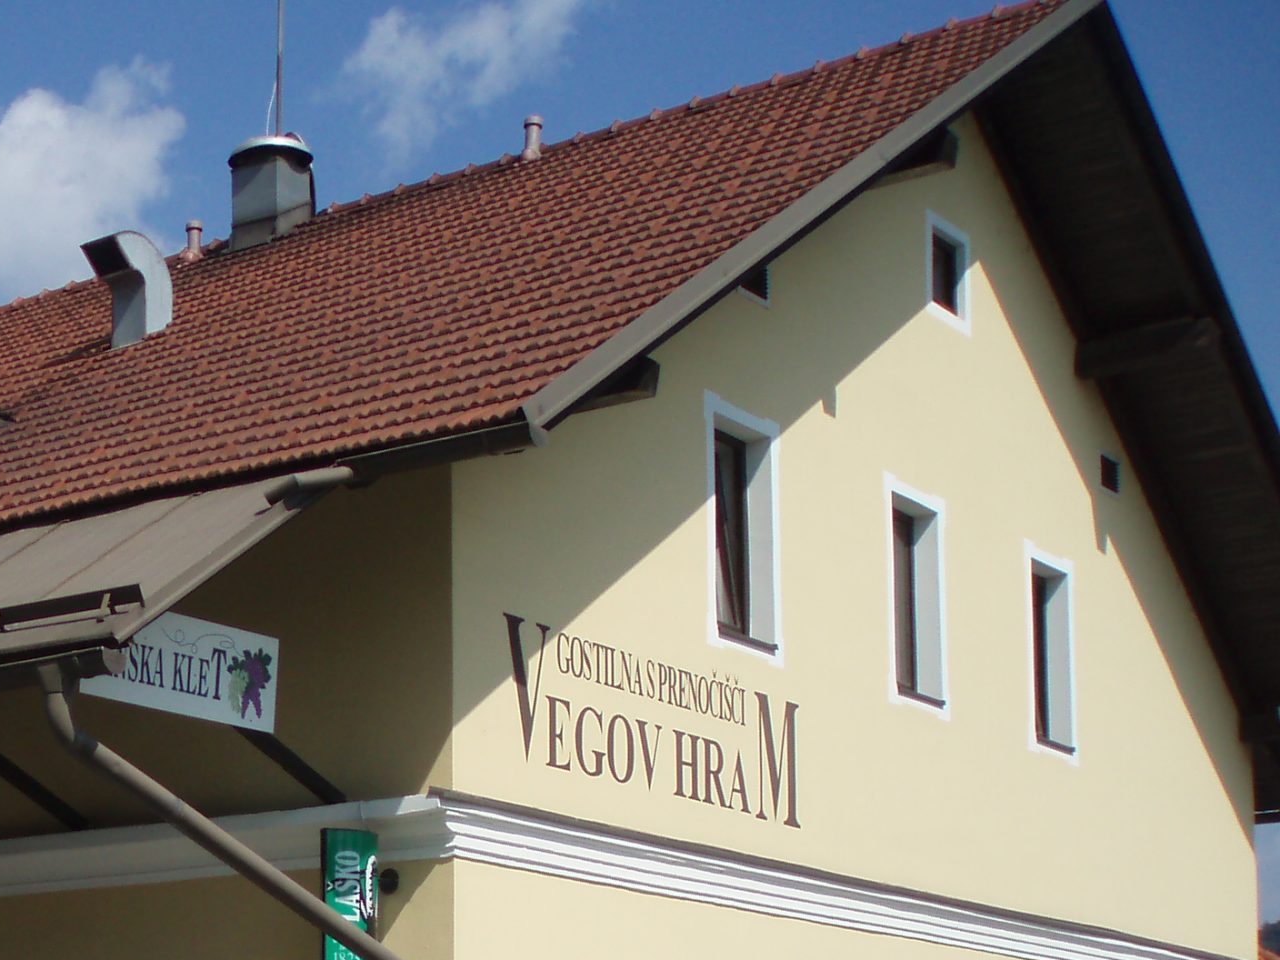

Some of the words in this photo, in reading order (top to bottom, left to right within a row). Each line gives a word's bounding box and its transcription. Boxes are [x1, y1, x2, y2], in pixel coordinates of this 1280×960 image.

[114, 641, 165, 689] SKA
[171, 647, 228, 701] KLET
[557, 632, 643, 697] GOSTILNA
[646, 659, 656, 699] S
[658, 663, 747, 727] PRENOČIŠČI
[503, 612, 662, 792] VEGOV
[672, 691, 801, 829] HRAM
[327, 850, 361, 922] LAŠKO
